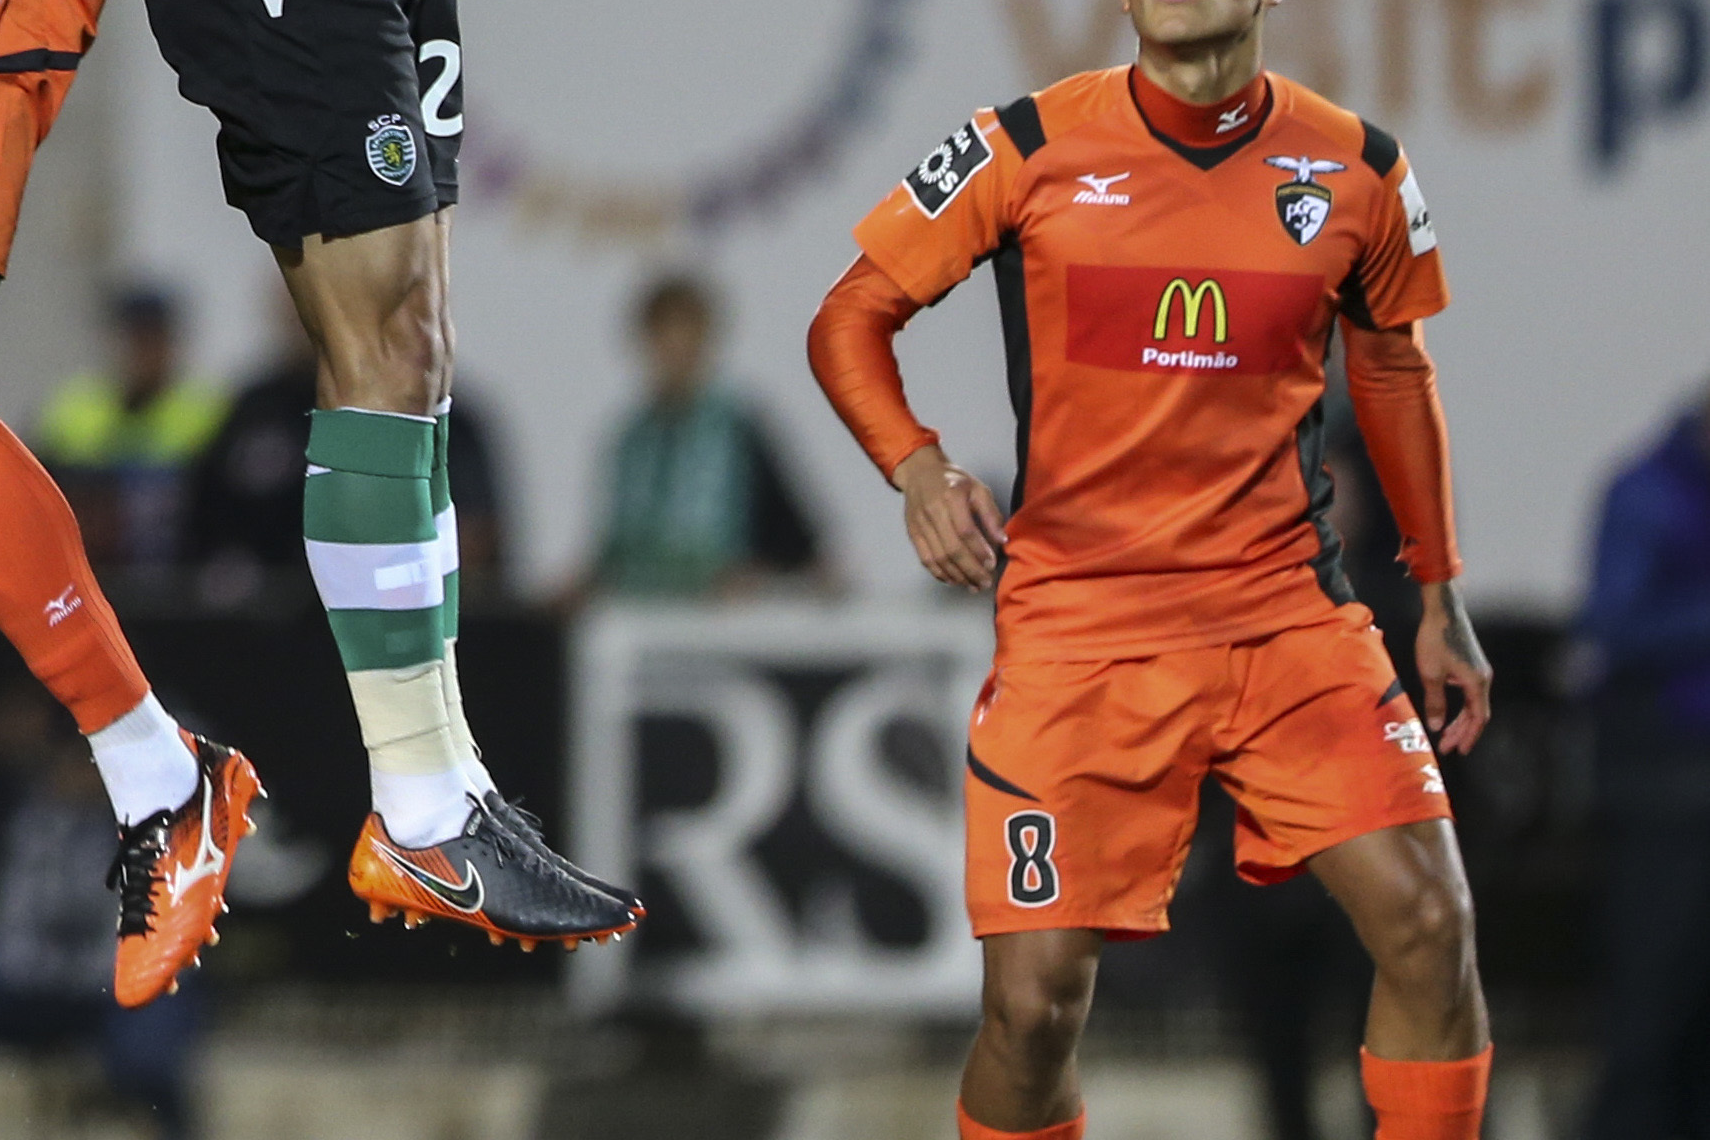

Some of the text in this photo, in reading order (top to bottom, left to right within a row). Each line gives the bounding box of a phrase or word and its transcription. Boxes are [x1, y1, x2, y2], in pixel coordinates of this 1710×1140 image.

[418, 39, 464, 137] 2
[1142, 347, 1239, 369] Portimão
[1003, 809, 1059, 907] 8
